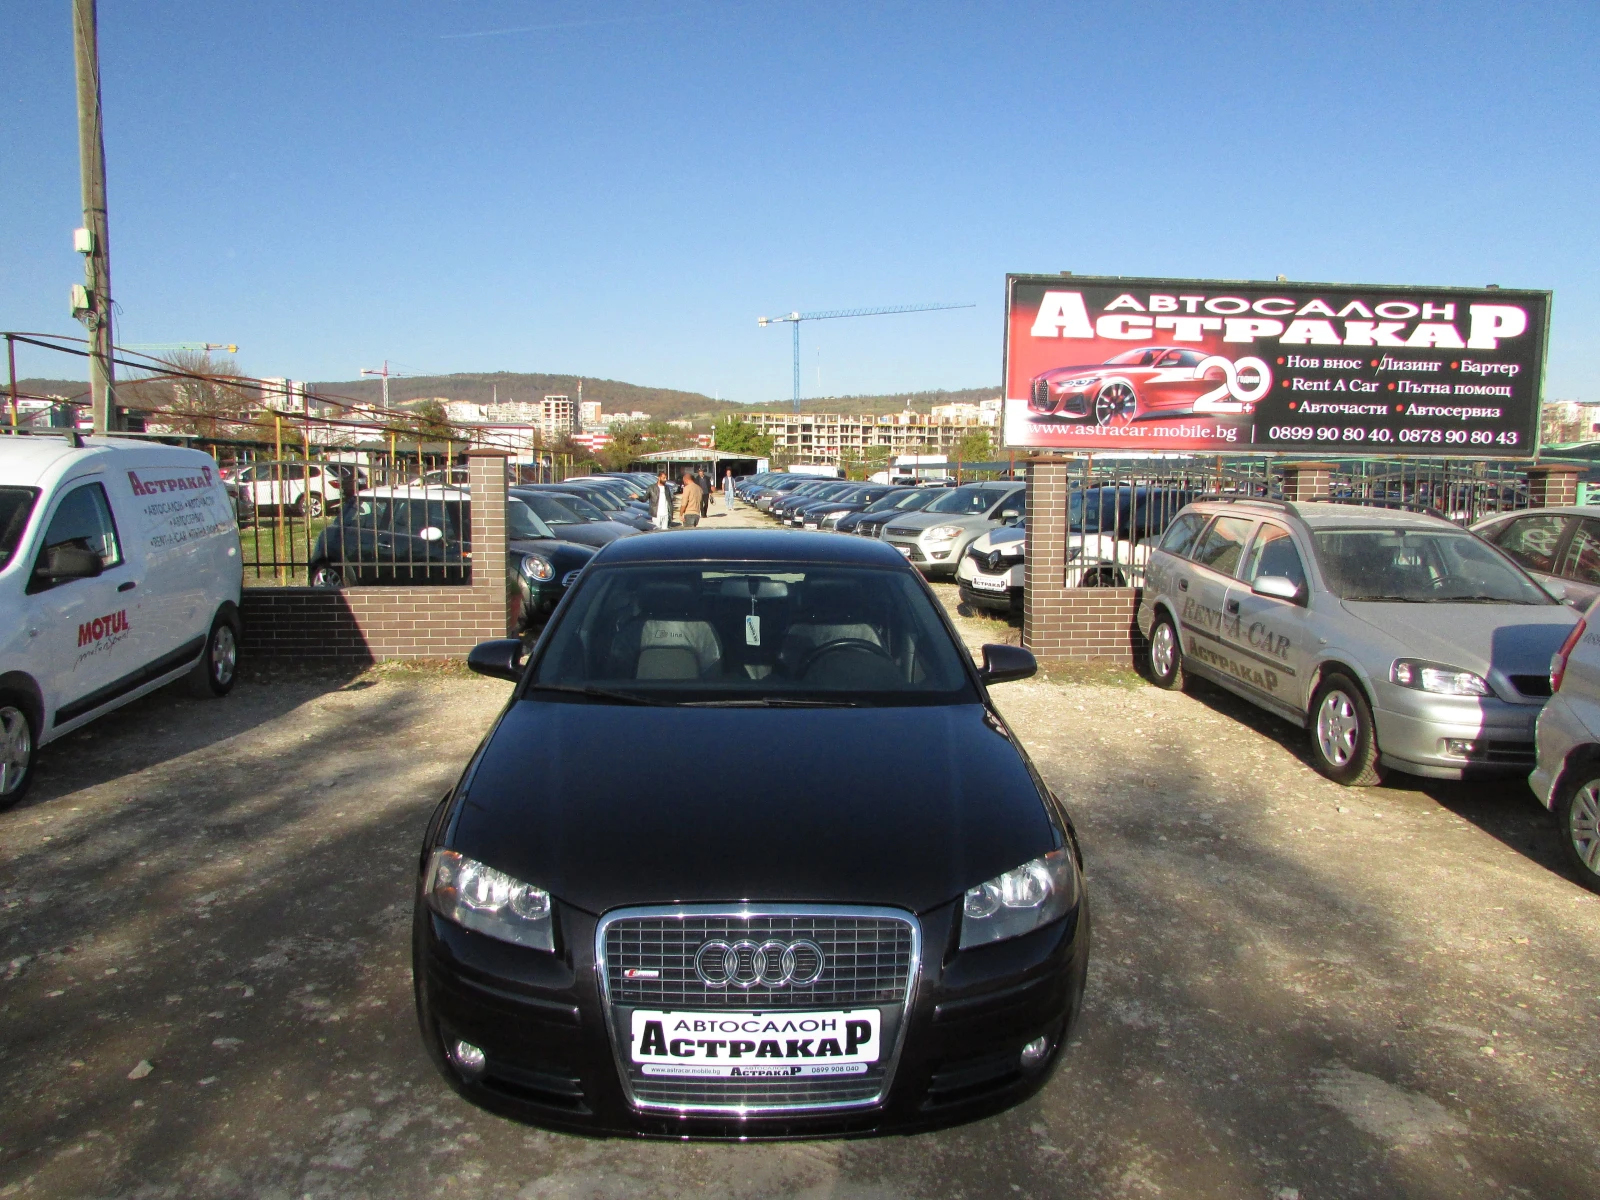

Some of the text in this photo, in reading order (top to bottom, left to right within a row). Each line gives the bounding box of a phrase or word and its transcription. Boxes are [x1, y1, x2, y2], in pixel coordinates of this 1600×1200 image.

[1104, 294, 1457, 321] АВТОСАЛОН
[1030, 291, 1527, 350] АСТРАКАР
[1287, 355, 1362, 370] Нов внос
[1380, 357, 1442, 373] Лизинг
[1460, 360, 1520, 377] Бартер
[1292, 378, 1379, 393] Rent A Car
[1397, 380, 1511, 398] Пътна помощ
[1298, 401, 1388, 415] Авточасти
[1405, 404, 1501, 420] Автосервиз
[1026, 423, 1237, 442] www.astracar.mobile.bg
[1269, 426, 1518, 445] 0899 90 80 40, 0878 90 80 43
[127, 465, 213, 496] АСТРАКАР
[77, 609, 129, 647] MOTUL
[1188, 636, 1279, 692] АСТРАКАР
[673, 1019, 837, 1033] АВТОСАЛОН
[639, 1019, 872, 1058] АСТРАКАР
[651, 1066, 721, 1075] www.astracar.mobile.bg
[730, 1066, 802, 1077] АСТРАКАР
[811, 1066, 829, 1074] 0899
